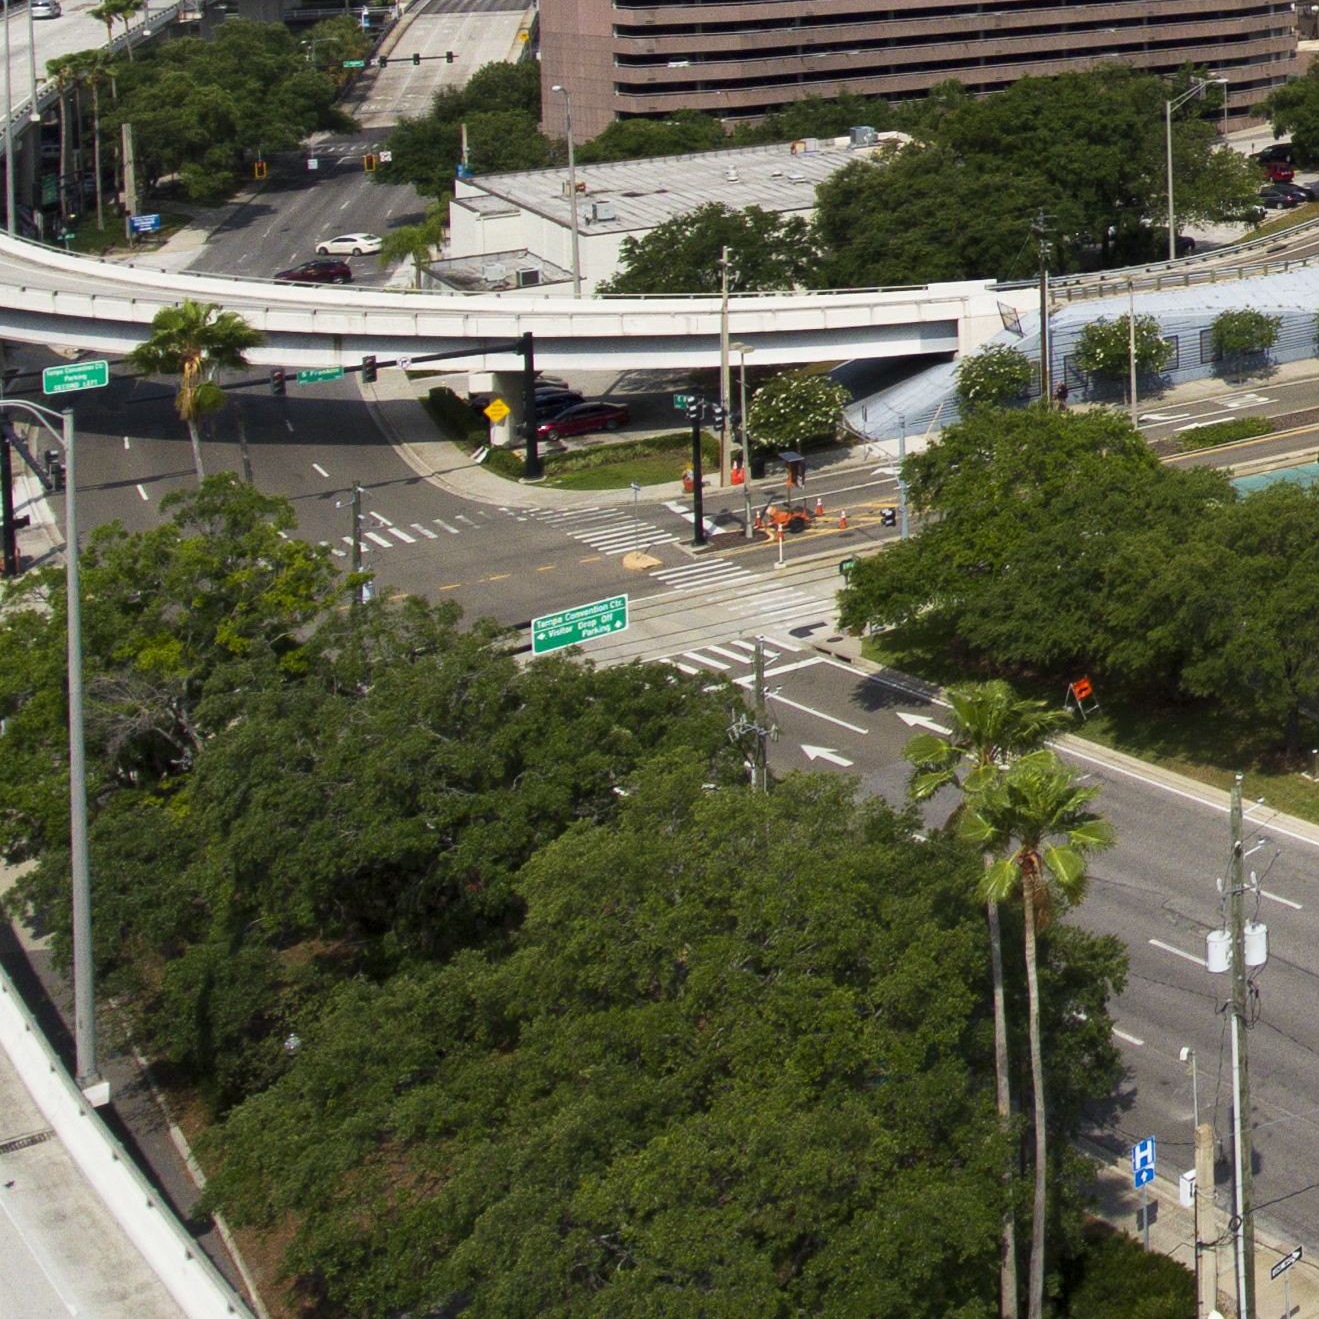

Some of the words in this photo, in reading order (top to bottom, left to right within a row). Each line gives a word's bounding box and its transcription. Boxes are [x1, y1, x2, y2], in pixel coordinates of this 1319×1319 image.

[46, 369, 63, 377] Tampa
[64, 365, 95, 374] Convention
[64, 374, 87, 382] Parking
[53, 382, 80, 391] SECOND
[536, 616, 563, 629] Tampa
[564, 603, 609, 621] Convention
[548, 625, 573, 638] Visitor
[577, 619, 597, 630] Drop
[600, 613, 613, 624] Off
[581, 624, 612, 638] Parking
[1135, 1140, 1152, 1170] H
